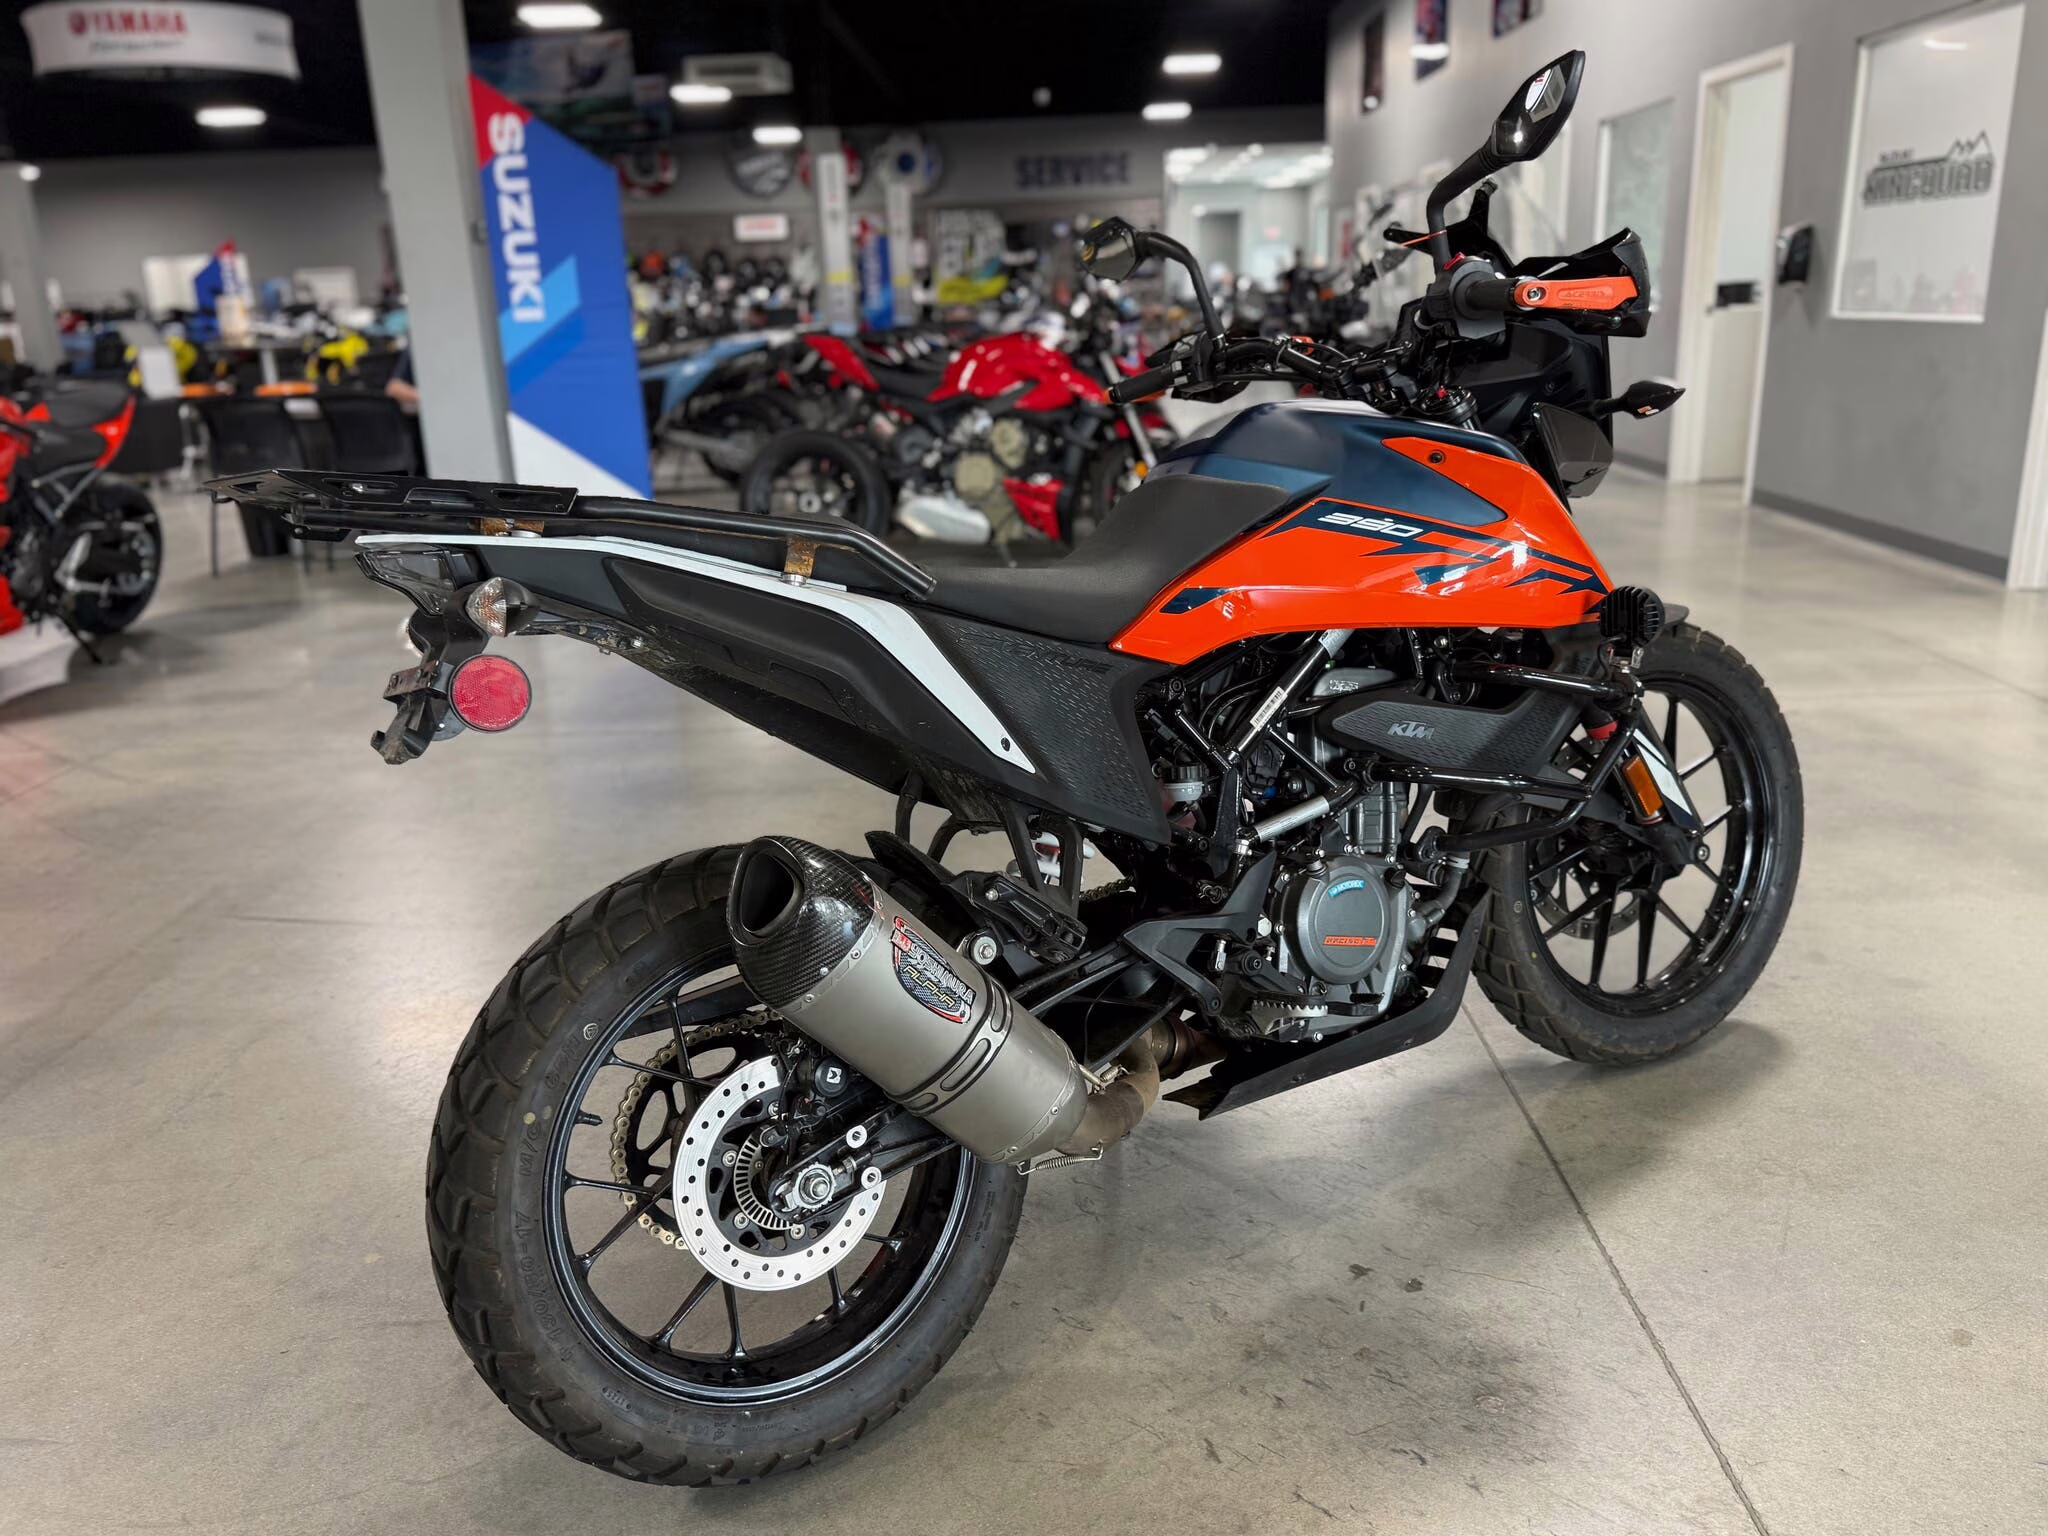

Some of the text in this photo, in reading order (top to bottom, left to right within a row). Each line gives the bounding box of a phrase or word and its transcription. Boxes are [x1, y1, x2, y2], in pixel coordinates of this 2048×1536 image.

[92, 11, 188, 34] YAMAHA
[1016, 152, 1131, 188] SERVICE
[487, 111, 547, 322] SUZUKI
[1317, 512, 1423, 537] 390
[1387, 720, 1435, 740] KTM
[903, 965, 956, 1008] ALPHA
[908, 942, 974, 1006] YOSHIMURA
